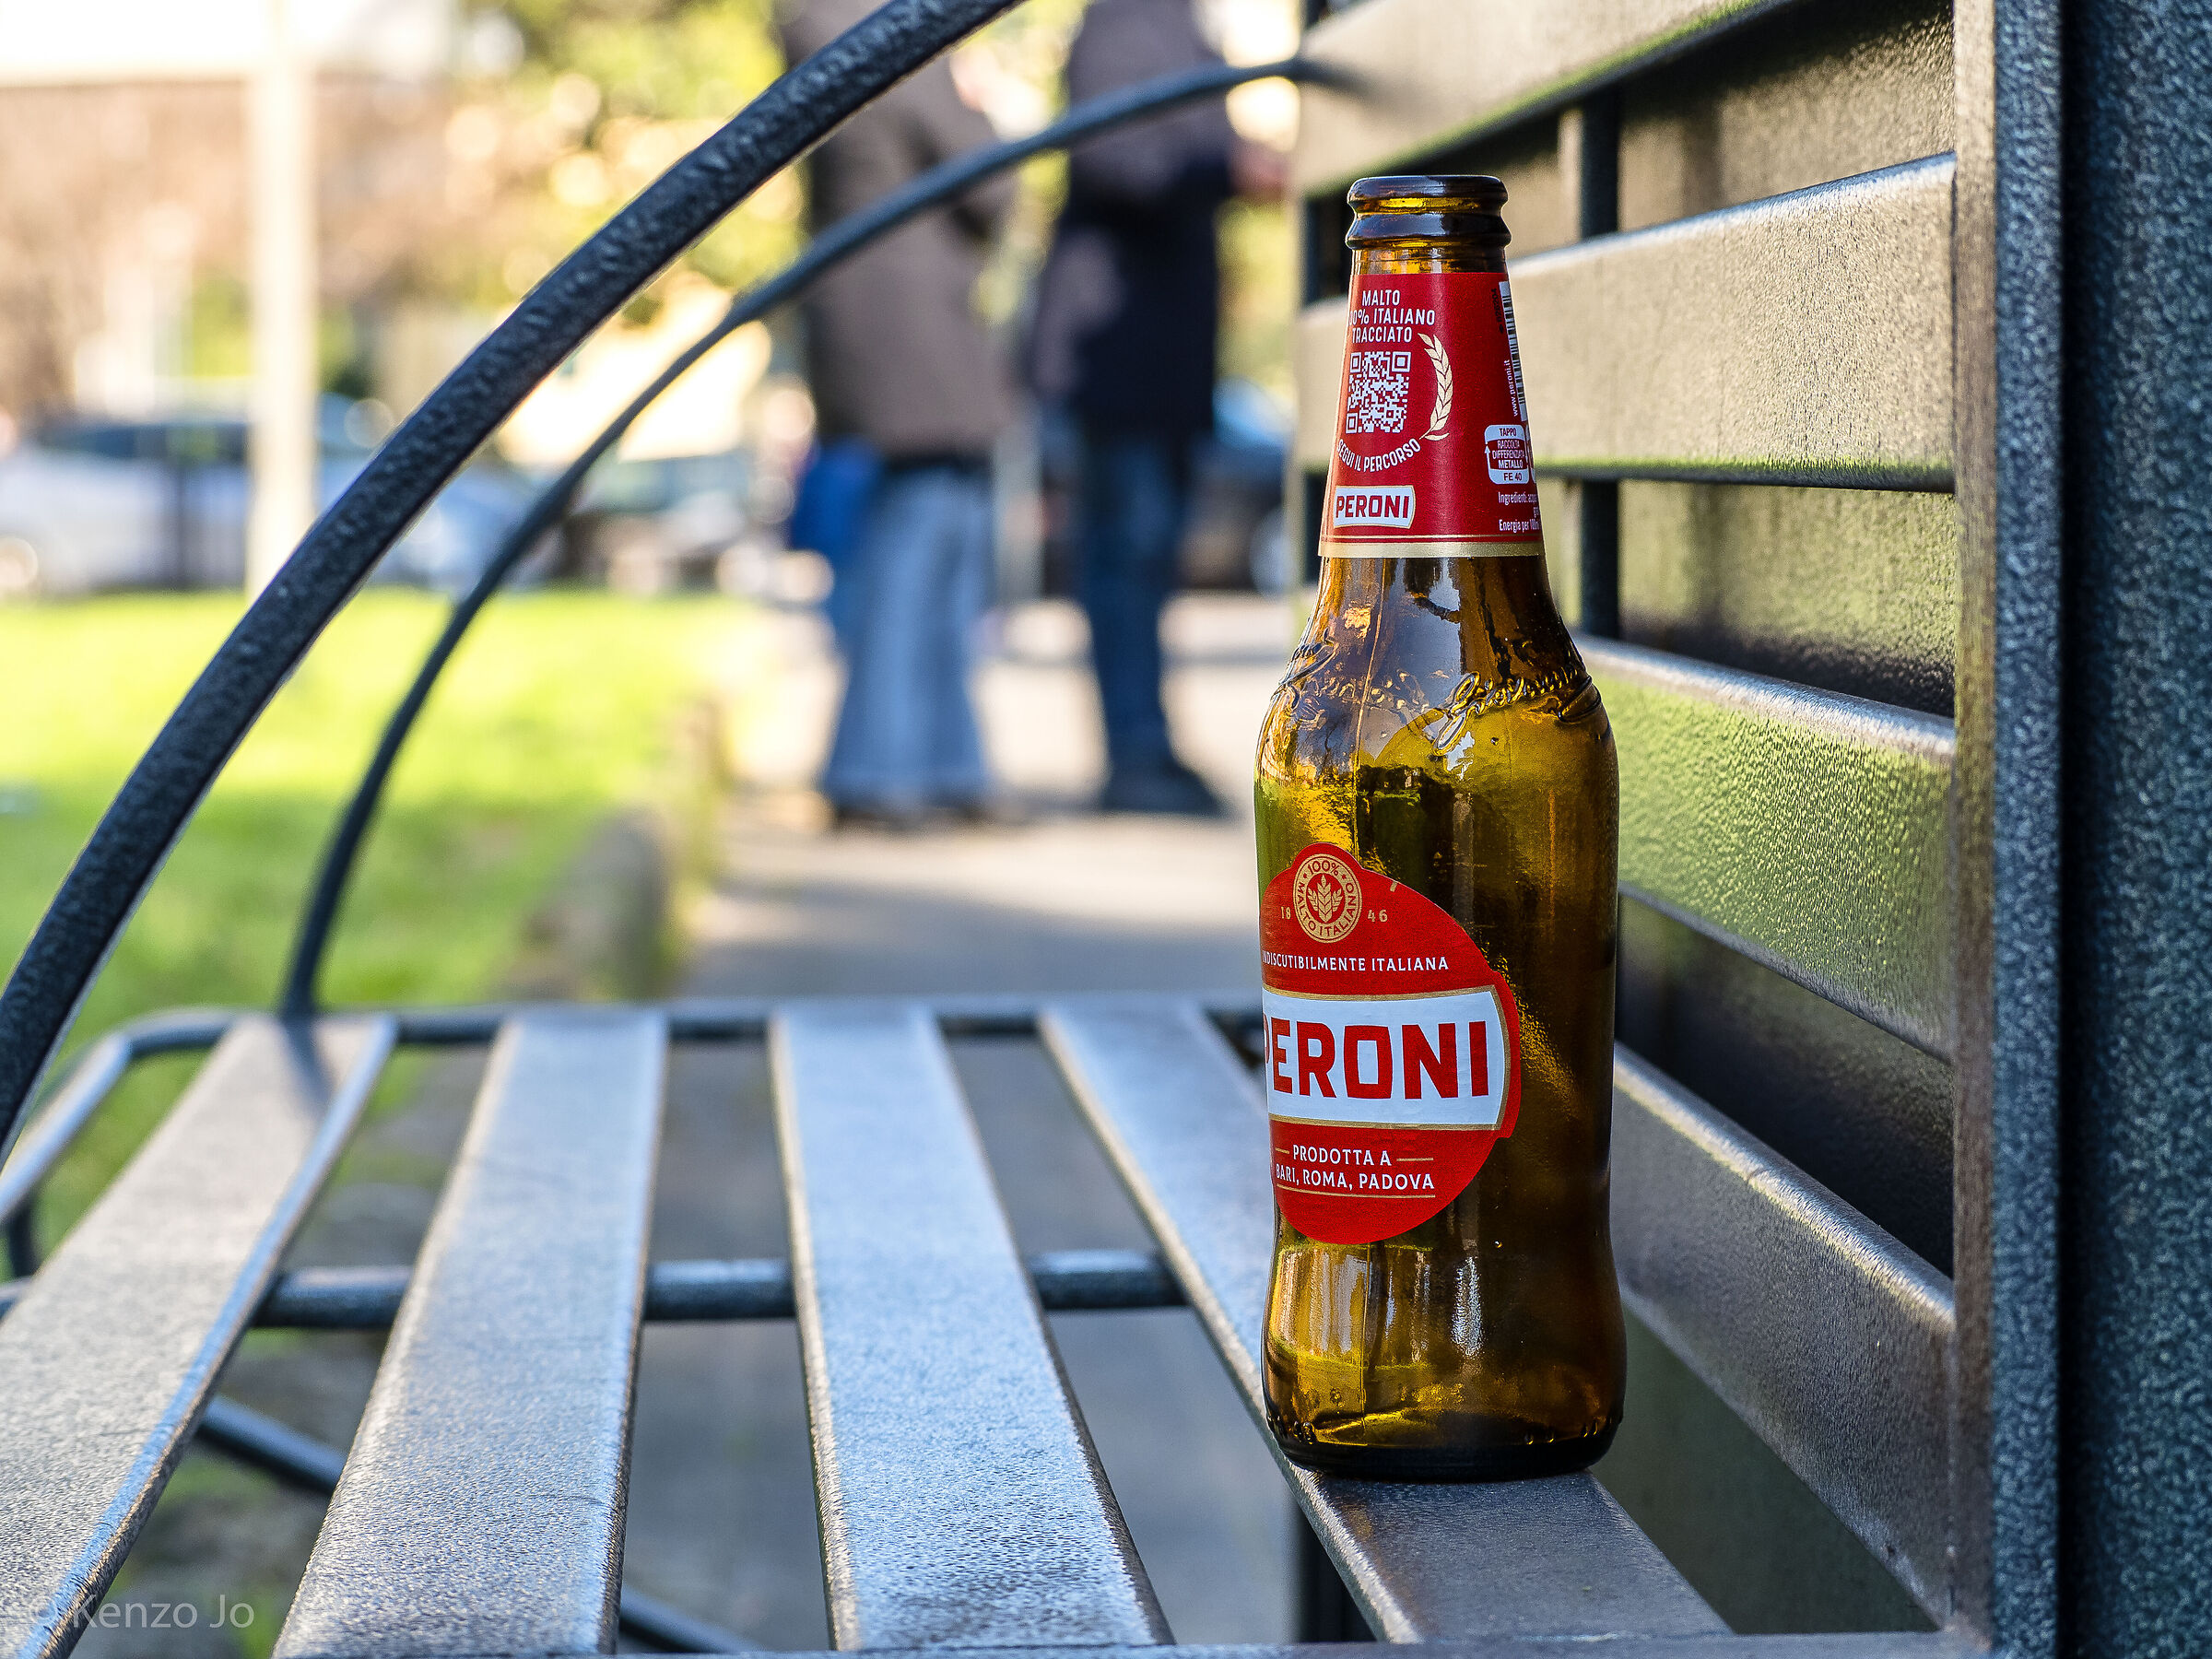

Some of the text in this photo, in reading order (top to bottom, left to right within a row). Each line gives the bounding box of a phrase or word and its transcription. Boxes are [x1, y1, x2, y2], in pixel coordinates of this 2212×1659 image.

[1361, 289, 1400, 306] MALTO
[1373, 308, 1435, 325] ITALIANO
[1352, 326, 1412, 343] TRACCIATO
[1503, 359, 1519, 417] www.peroni.it
[1499, 428, 1517, 437] TAPPO
[1497, 440, 1520, 449] RACCOLTA
[1337, 438, 1421, 473] SEGUI IL PERCORSO
[1498, 459, 1523, 468] METALLO
[1503, 473, 1523, 481] FE 40
[1335, 495, 1410, 518] PERONI
[1499, 519, 1521, 533] Energia
[1522, 521, 1530, 533] per
[1307, 860, 1339, 877] 100%
[1281, 906, 1388, 923] 18 46
[1296, 881, 1357, 936] MALTO ITALIANO
[1371, 957, 1449, 971] ITALIANA
[1293, 1145, 1392, 1166] PRODOTTA A
[1276, 1162, 1435, 1190] BARI, ROMA, PADOVA
